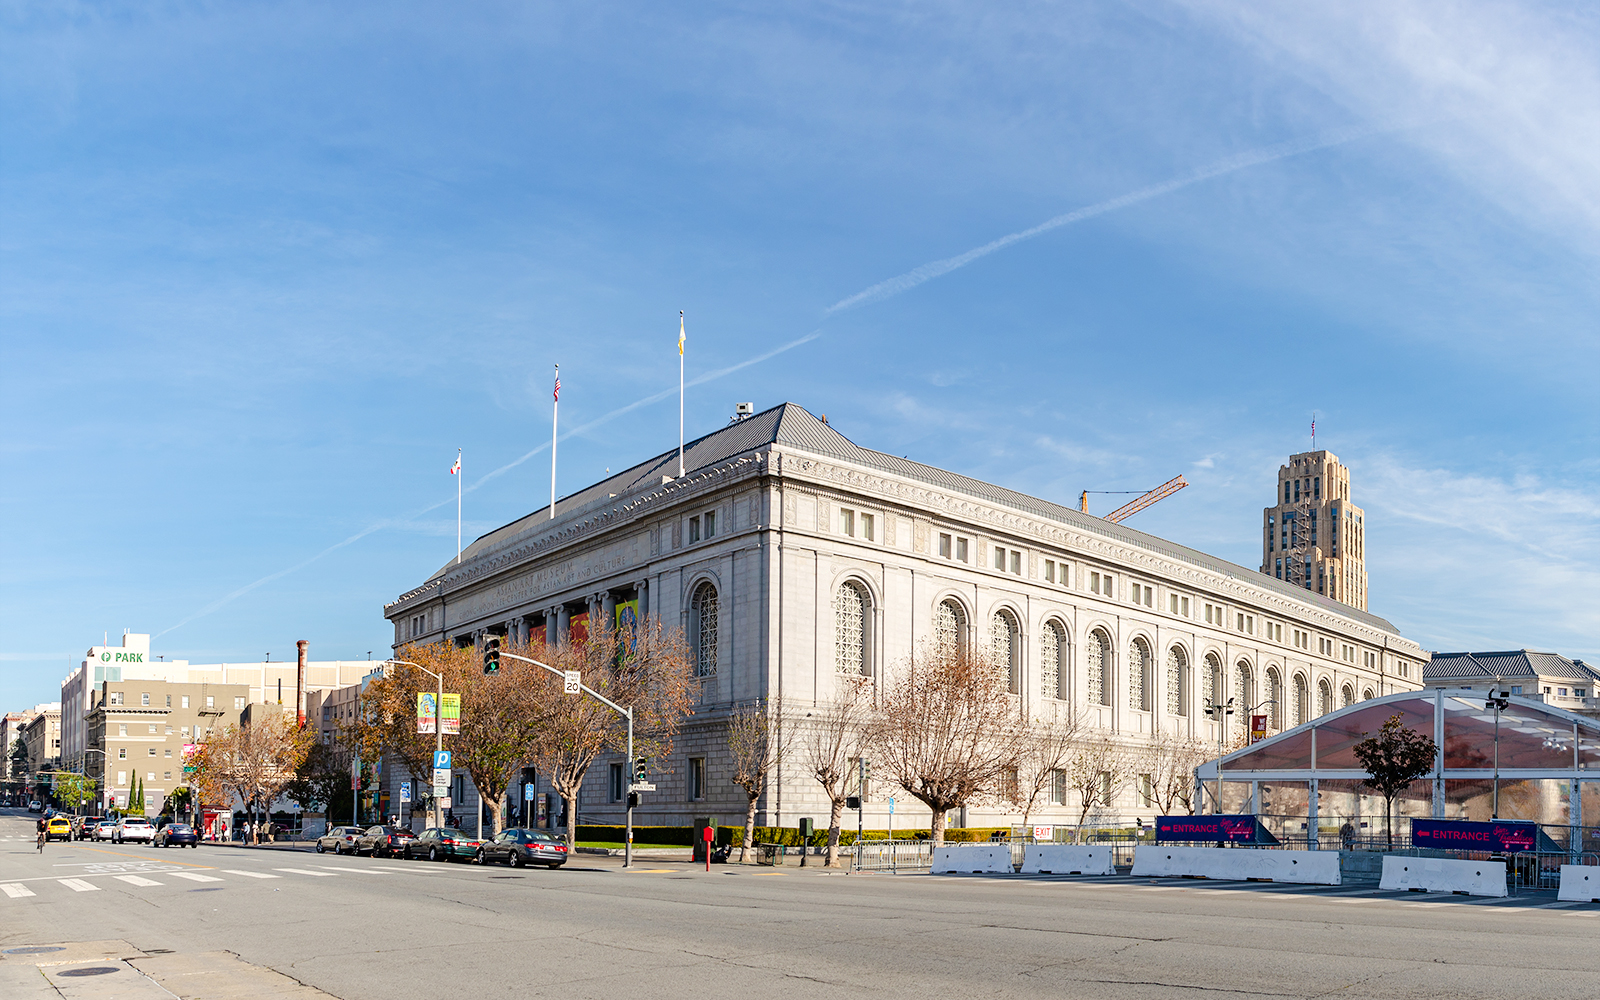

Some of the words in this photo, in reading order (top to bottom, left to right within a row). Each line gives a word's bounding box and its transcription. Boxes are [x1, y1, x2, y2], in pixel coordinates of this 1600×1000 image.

[496, 582, 518, 598] ASIAN
[520, 574, 534, 589] ART
[536, 562, 573, 582] MUSEUM
[506, 588, 528, 604] CENTER
[529, 584, 541, 595] FOR
[542, 577, 562, 591] ASIAN
[562, 572, 575, 585] ART
[577, 567, 591, 580] AND
[593, 555, 626, 574] CULTURE
[115, 652, 143, 663] PARK
[567, 683, 578, 691] 20
[1035, 827, 1051, 836] EXIT
[1172, 824, 1218, 833] ENTRANCE
[1433, 830, 1490, 841] ENTRANCE
